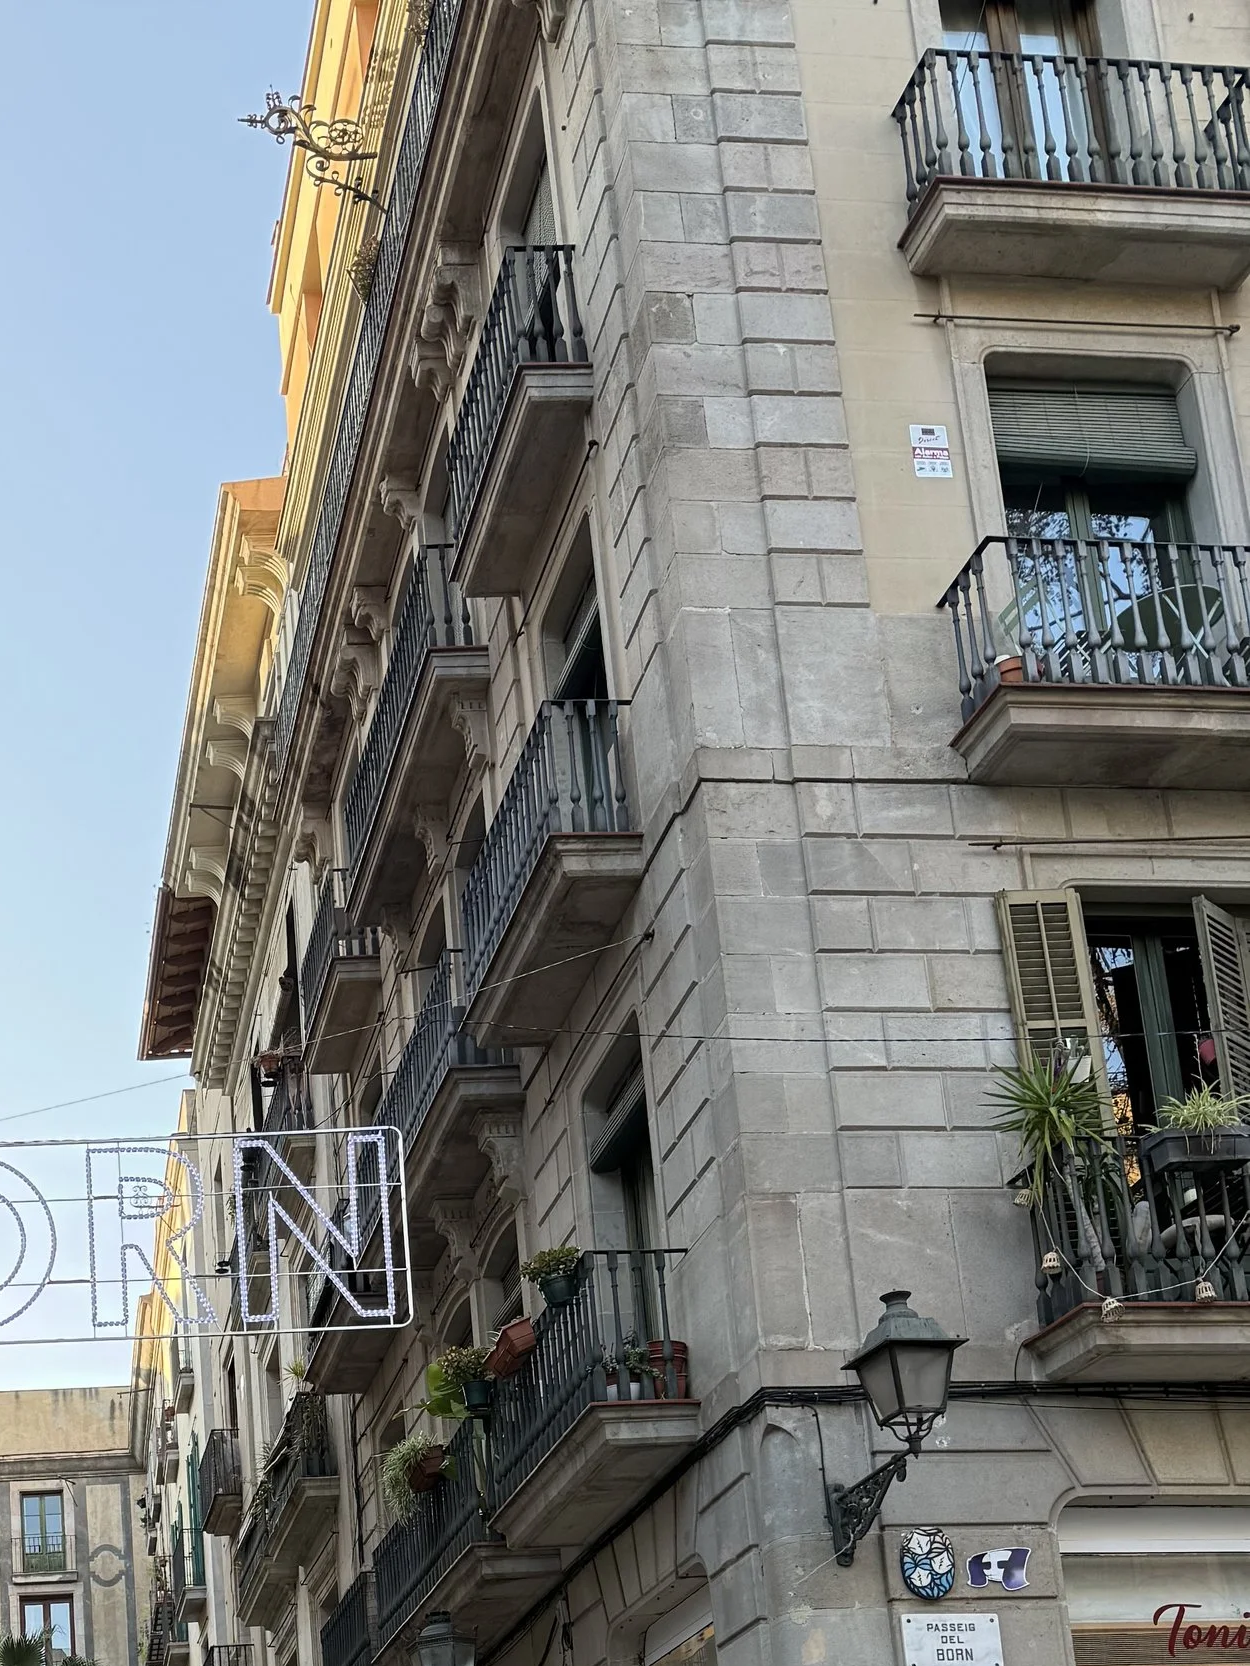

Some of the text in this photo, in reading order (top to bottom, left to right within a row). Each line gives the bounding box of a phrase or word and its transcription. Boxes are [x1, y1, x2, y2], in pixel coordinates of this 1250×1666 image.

[914, 447, 949, 457] Alarma
[926, 1623, 976, 1632] PASSEIG
[940, 1635, 965, 1644] DEL
[936, 1648, 974, 1661] BORN
